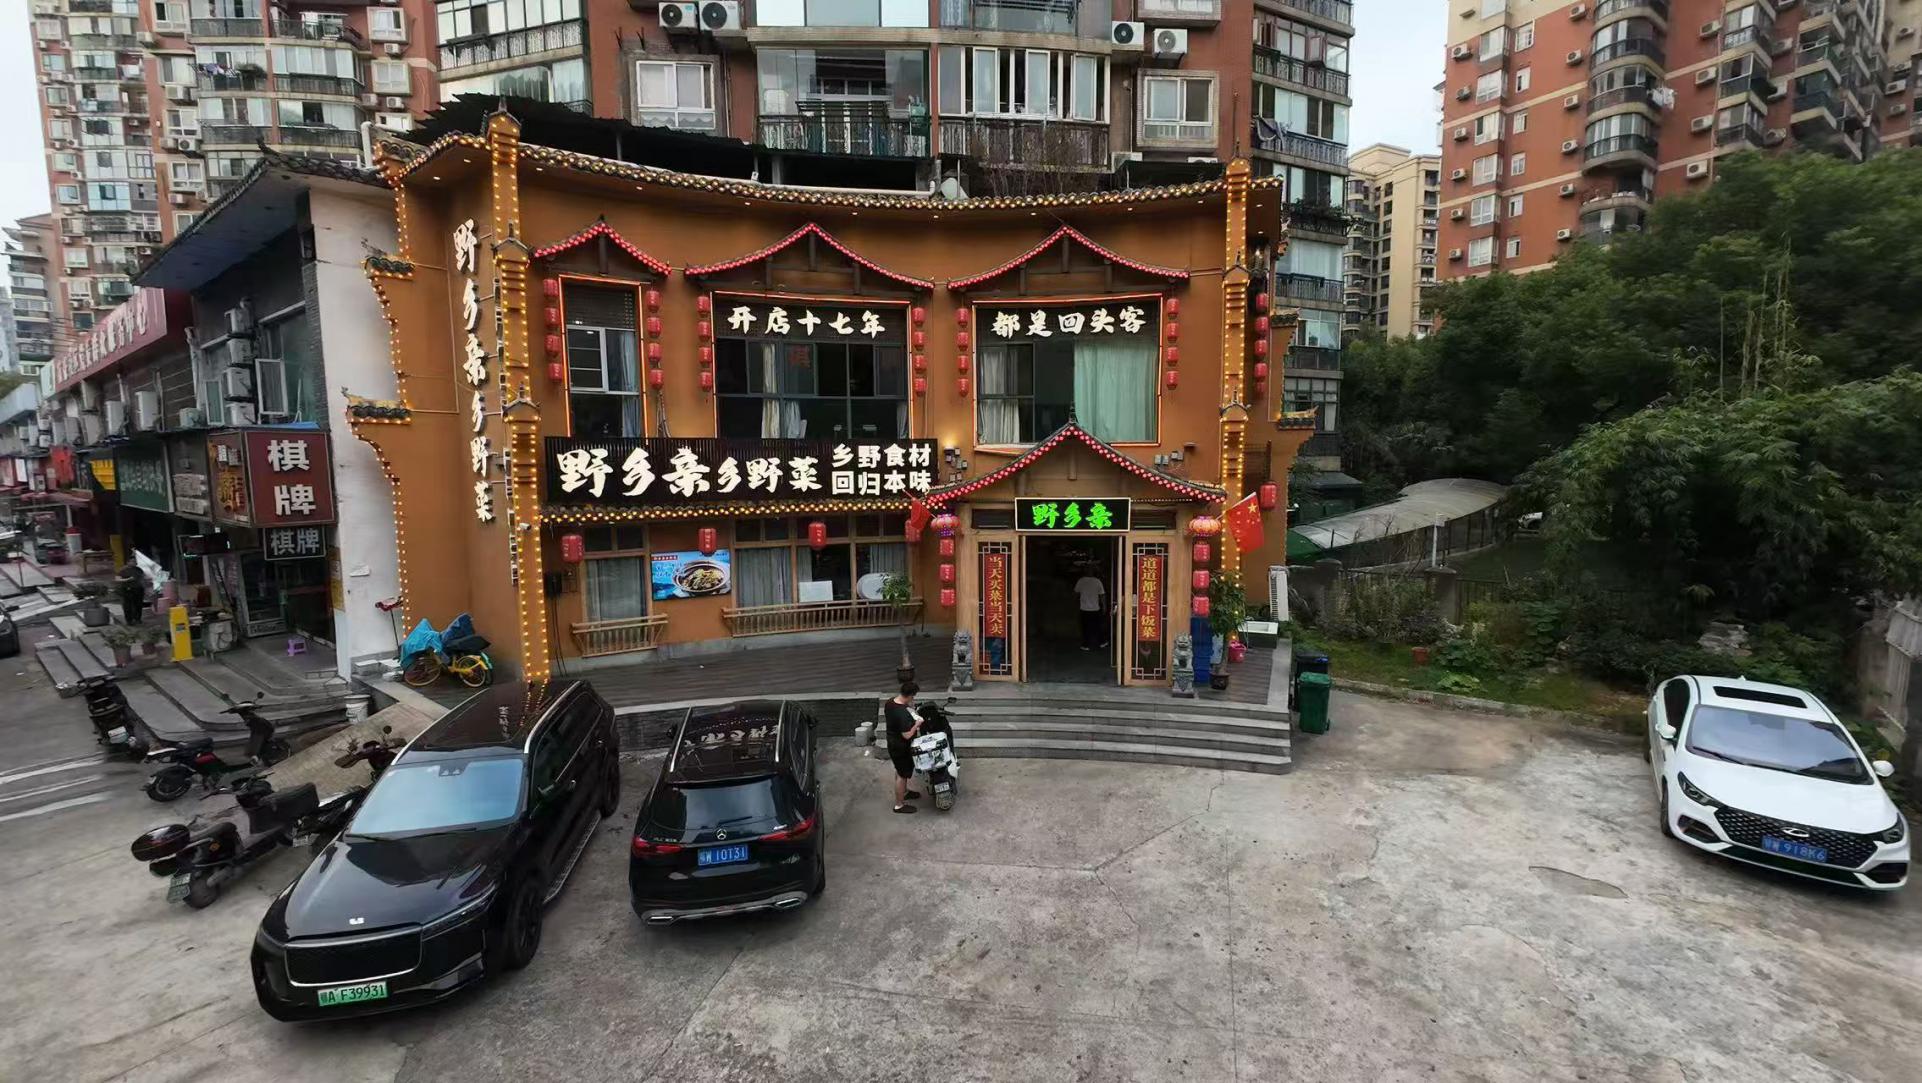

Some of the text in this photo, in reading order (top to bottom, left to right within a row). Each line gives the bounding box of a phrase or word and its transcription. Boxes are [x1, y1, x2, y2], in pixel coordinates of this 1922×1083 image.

[728, 305, 886, 339] 开店十七年
[990, 305, 1147, 339] 都是回头客
[453, 218, 494, 522] 野乡亲乡野菜
[832, 443, 932, 468] 乡野食材
[268, 439, 316, 516] 棋牌
[832, 470, 932, 498] 回归本味
[1032, 503, 1113, 530] 野乡亲
[270, 528, 320, 556] 棋牌
[1141, 557, 1157, 638] 道道都是下饭菜
[319, 984, 385, 1004] AF39931
